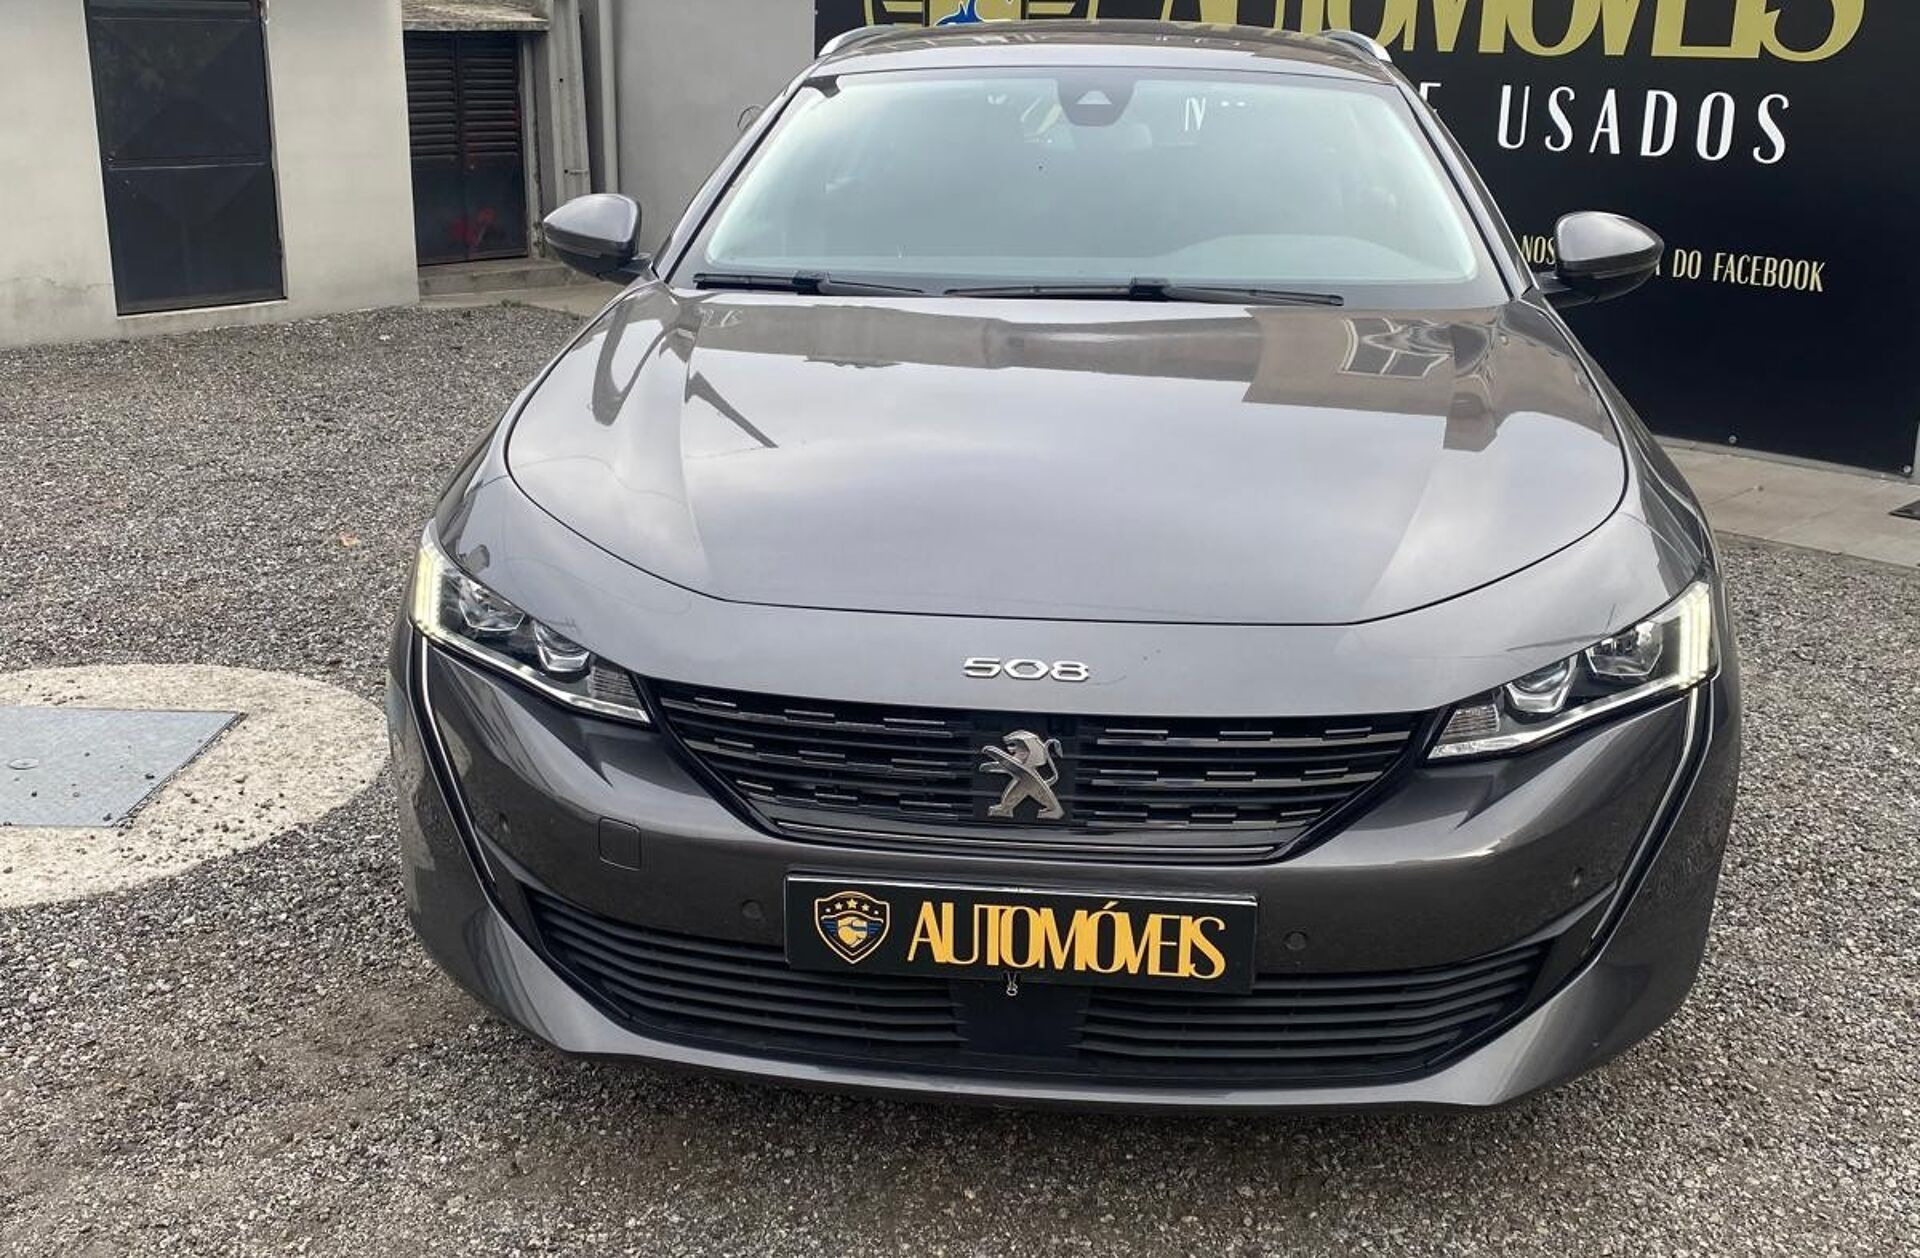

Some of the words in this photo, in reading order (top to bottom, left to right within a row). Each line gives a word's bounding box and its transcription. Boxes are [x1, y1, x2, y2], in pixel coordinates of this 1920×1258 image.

[1498, 85, 1790, 164] USADOS
[1521, 235, 1556, 265] NOS
[1673, 249, 1702, 279] DO
[1713, 252, 1825, 292] FACEBOOK
[963, 657, 1090, 682] 508
[907, 901, 1226, 979] AUTOMÓVEIS
